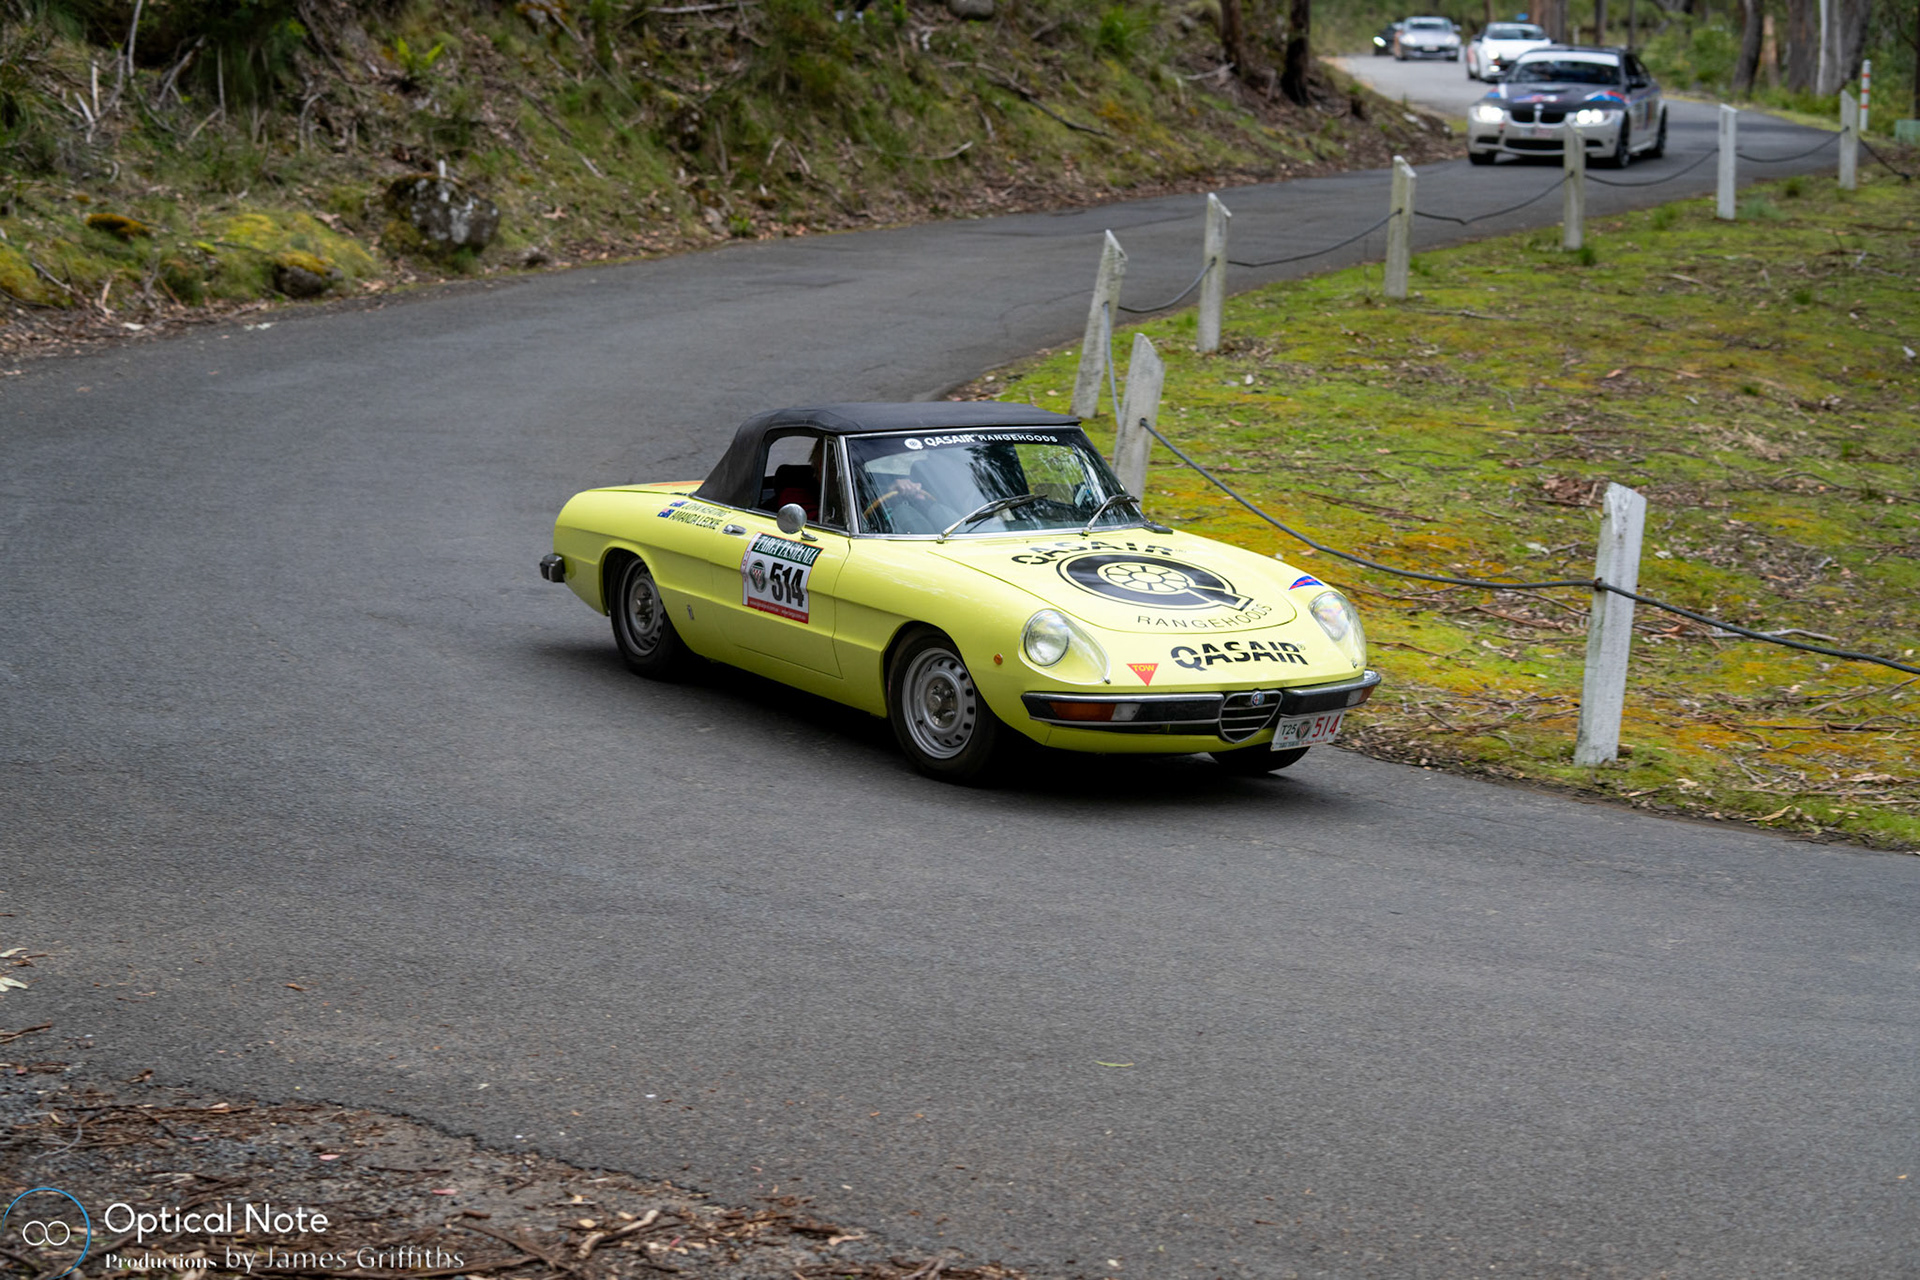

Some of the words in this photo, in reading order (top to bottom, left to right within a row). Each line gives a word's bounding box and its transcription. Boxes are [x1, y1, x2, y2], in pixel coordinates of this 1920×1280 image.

[924, 434, 976, 447] QASAIR
[978, 433, 1058, 443] RANGEHOODS
[669, 510, 702, 526] AMANDA
[754, 534, 784, 555] TARGA
[769, 562, 805, 608] 514
[1137, 603, 1273, 629] RANGEHOODS
[1131, 664, 1155, 673] TOW
[1281, 724, 1298, 736] T25
[1311, 714, 1341, 738] 514
